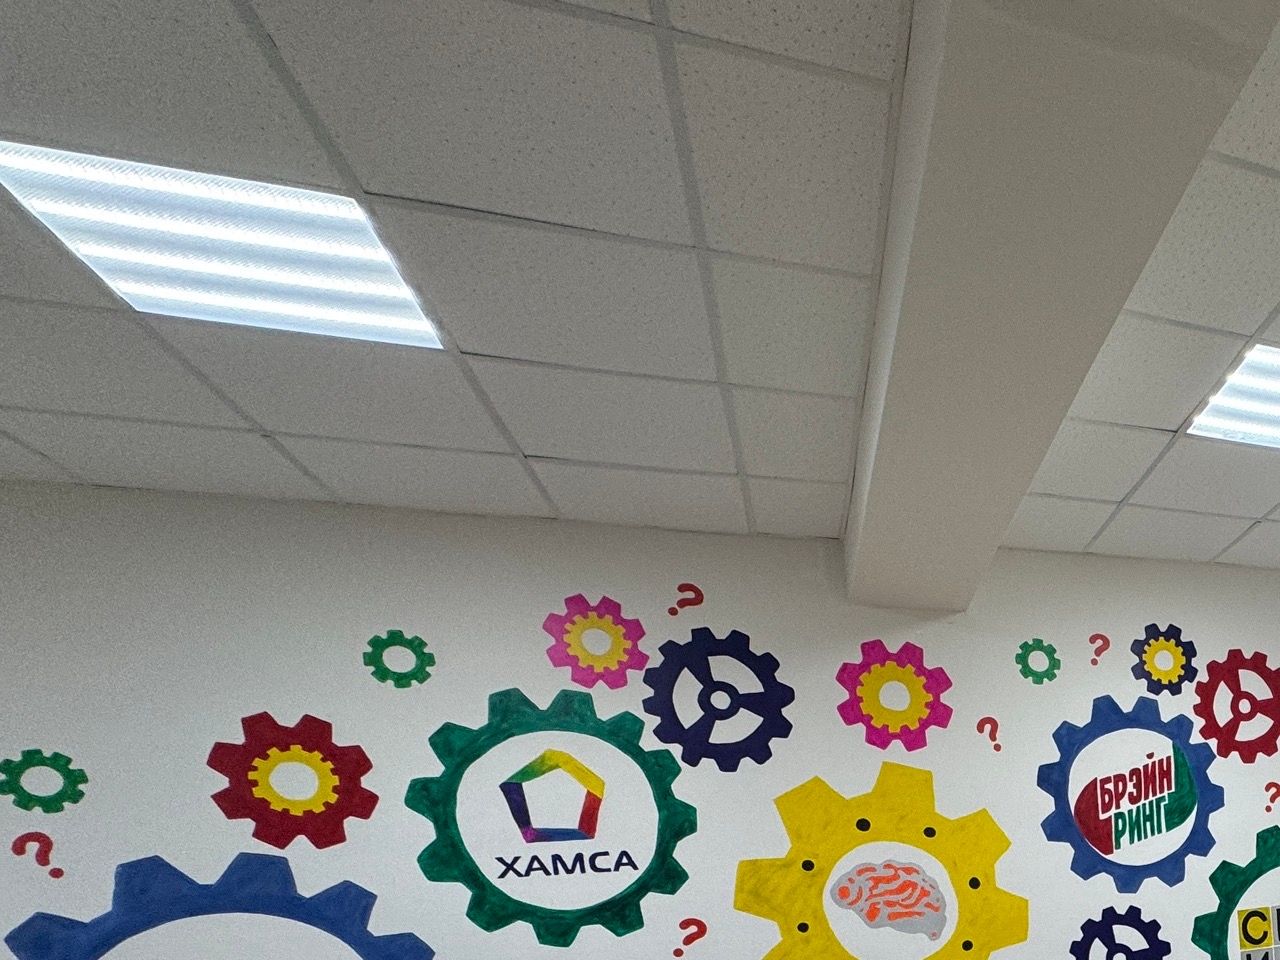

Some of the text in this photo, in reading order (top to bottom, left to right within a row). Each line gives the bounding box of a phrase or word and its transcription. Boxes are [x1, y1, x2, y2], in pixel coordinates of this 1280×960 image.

[1100, 752, 1173, 814] БРЭЙН
[1113, 794, 1167, 850] РИНГ
[495, 850, 639, 879] ХАМСА
